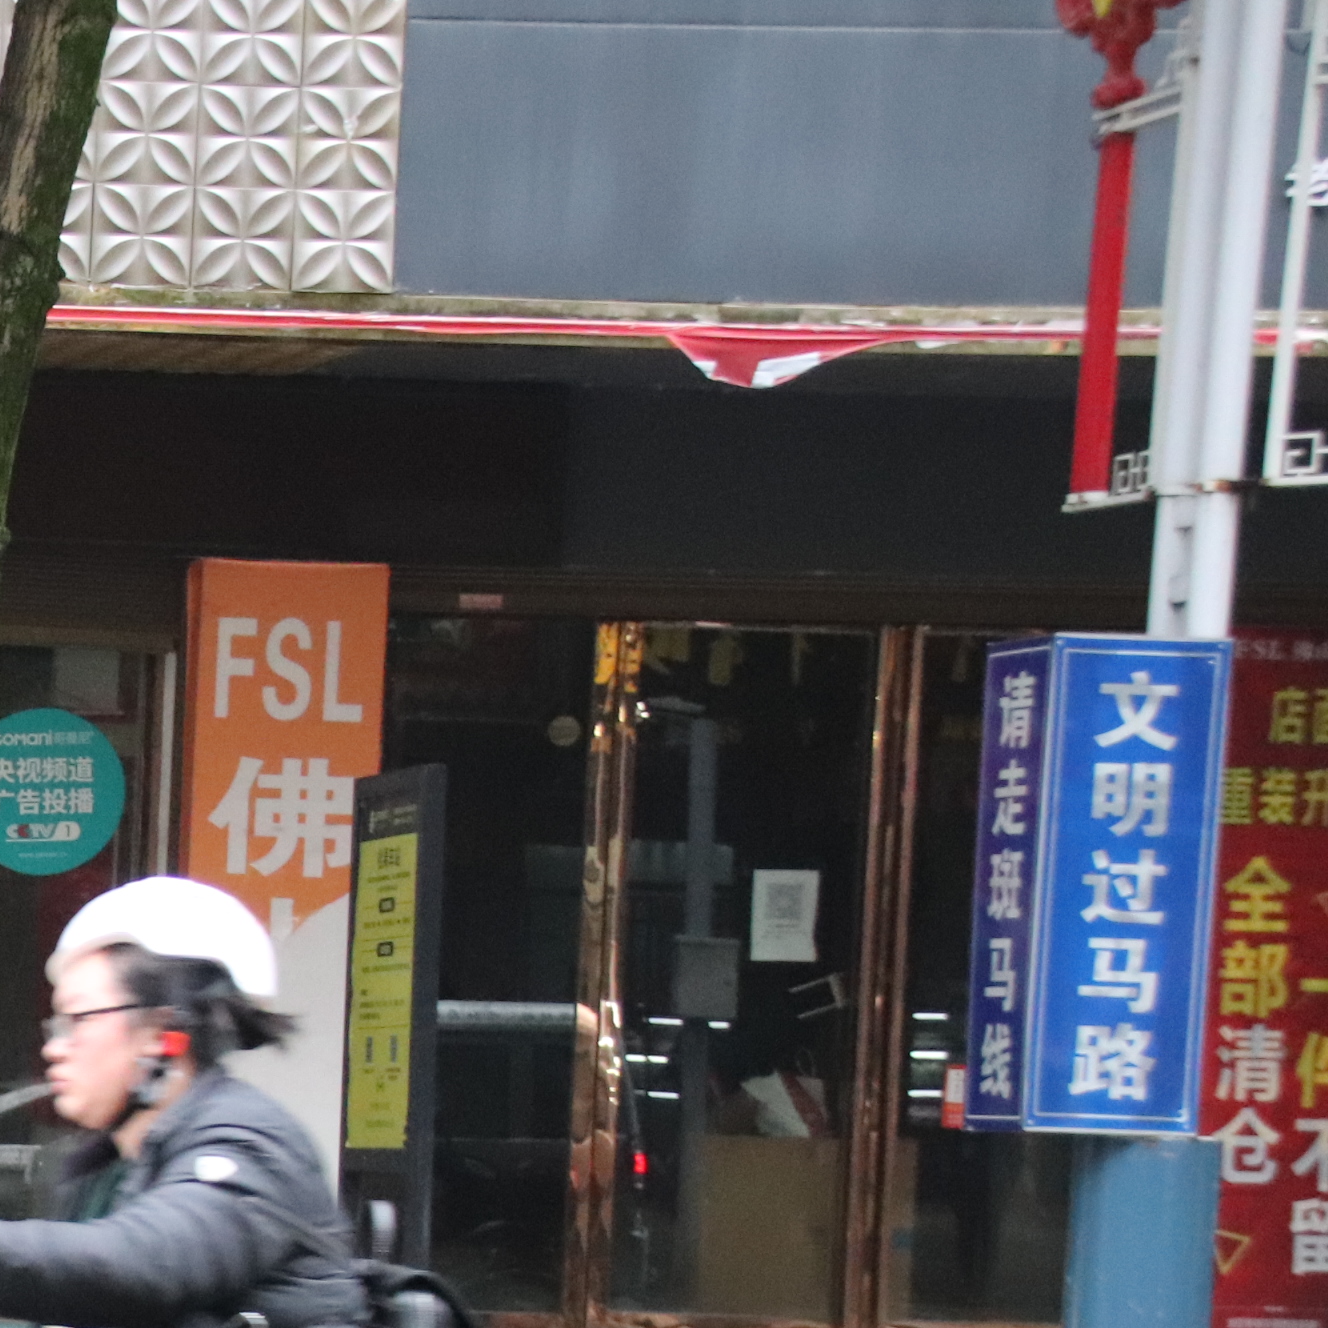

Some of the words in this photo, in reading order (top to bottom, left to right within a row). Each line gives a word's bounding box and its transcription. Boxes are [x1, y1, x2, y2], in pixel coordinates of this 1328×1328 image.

[213, 616, 363, 724] FSL
[208, 756, 354, 938] 佛
[979, 671, 1037, 1100] 请走斑马线
[1068, 670, 1180, 1101] 文明过马路
[1215, 856, 1292, 1184] 全部清仓
